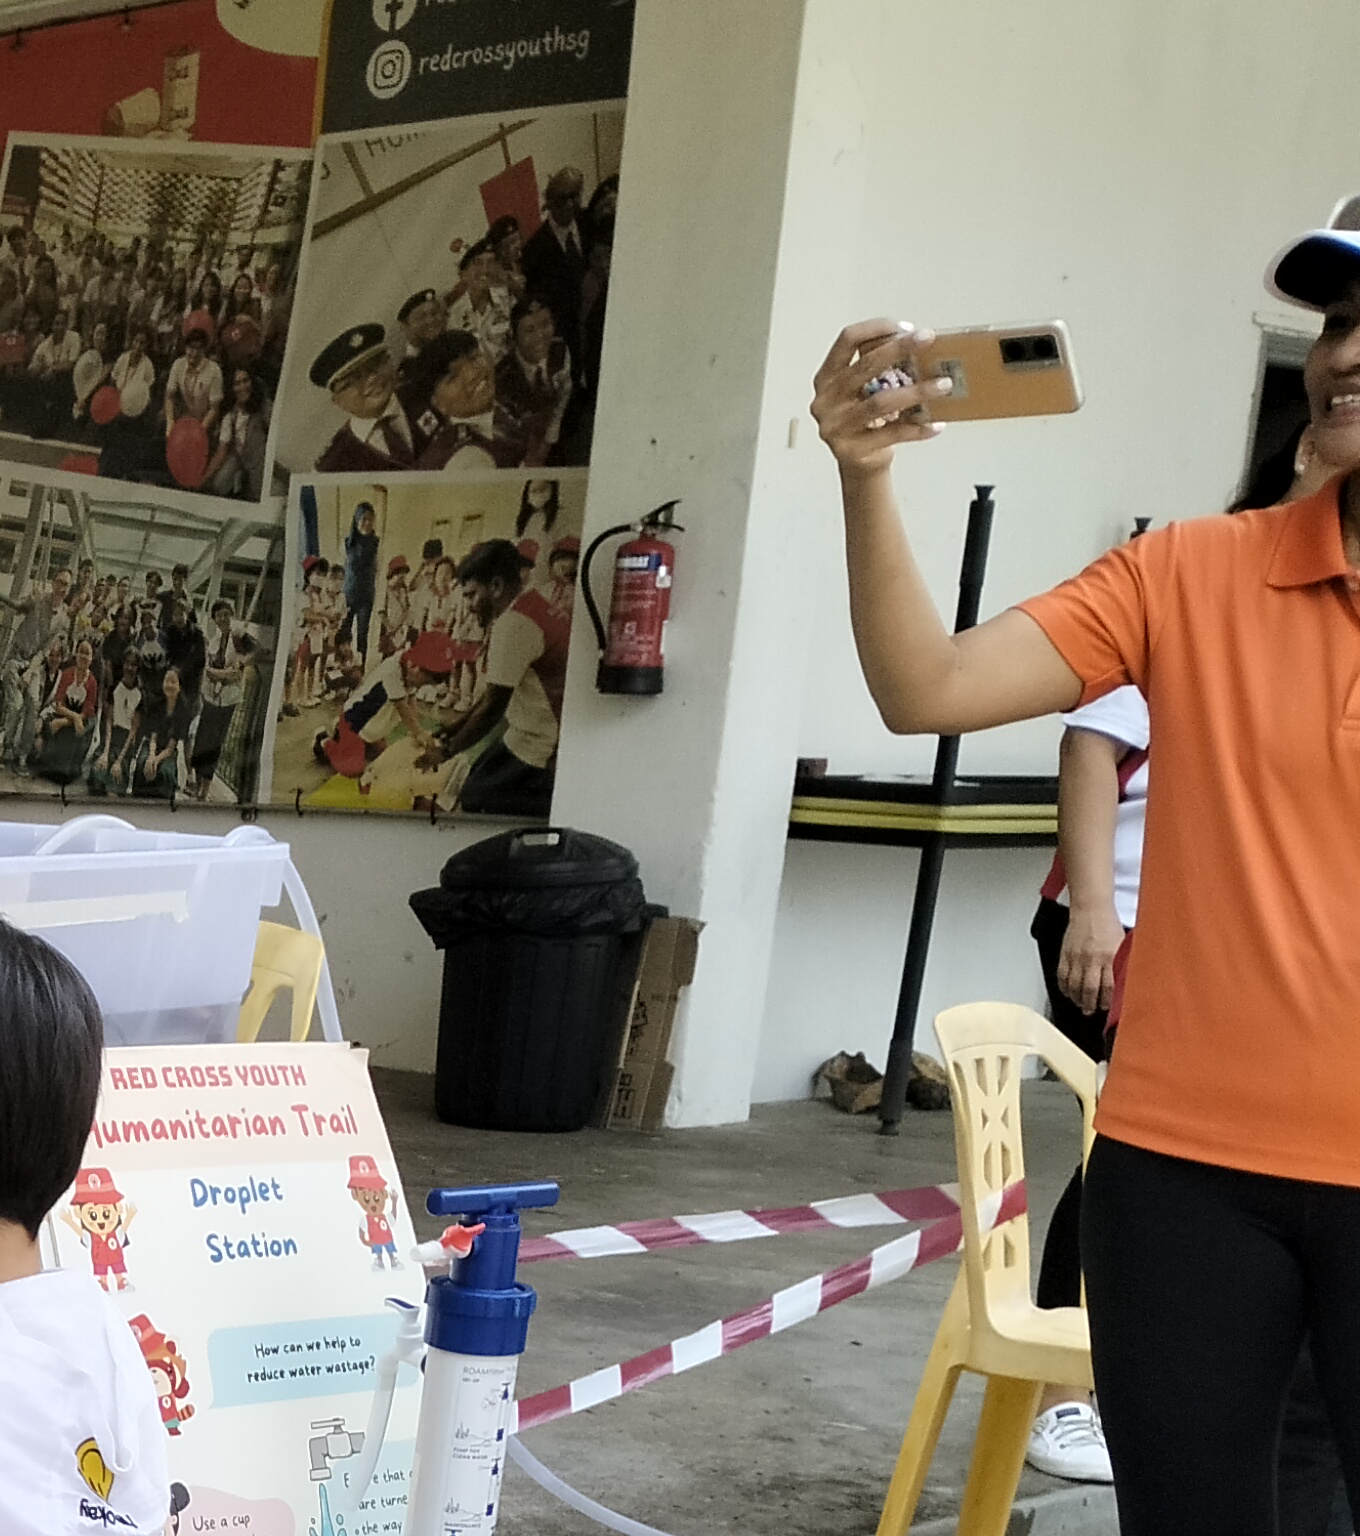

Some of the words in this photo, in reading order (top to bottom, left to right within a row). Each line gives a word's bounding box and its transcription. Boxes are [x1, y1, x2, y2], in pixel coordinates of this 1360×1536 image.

[419, 25, 591, 75] redcrossyouthsg
[109, 1066, 158, 1090] RED
[161, 1065, 233, 1089] CROSS
[233, 1064, 307, 1087] YOUTH
[290, 1103, 359, 1137] Trail
[190, 1175, 283, 1215] Droplet
[206, 1232, 298, 1263] Station
[255, 1343, 279, 1358] How
[283, 1343, 303, 1354] can
[306, 1341, 321, 1351] we
[323, 1336, 346, 1353] help
[349, 1336, 361, 1347] to
[247, 1366, 285, 1383] reduce
[289, 1365, 322, 1378] water
[325, 1355, 375, 1375] wastage?
[383, 1468, 405, 1483] that
[359, 1498, 376, 1510] are
[381, 1494, 408, 1508] turne
[192, 1515, 216, 1531] Use
[220, 1518, 228, 1527] a
[232, 1515, 251, 1528] cup
[362, 1520, 378, 1535] the
[382, 1521, 402, 1534] way
